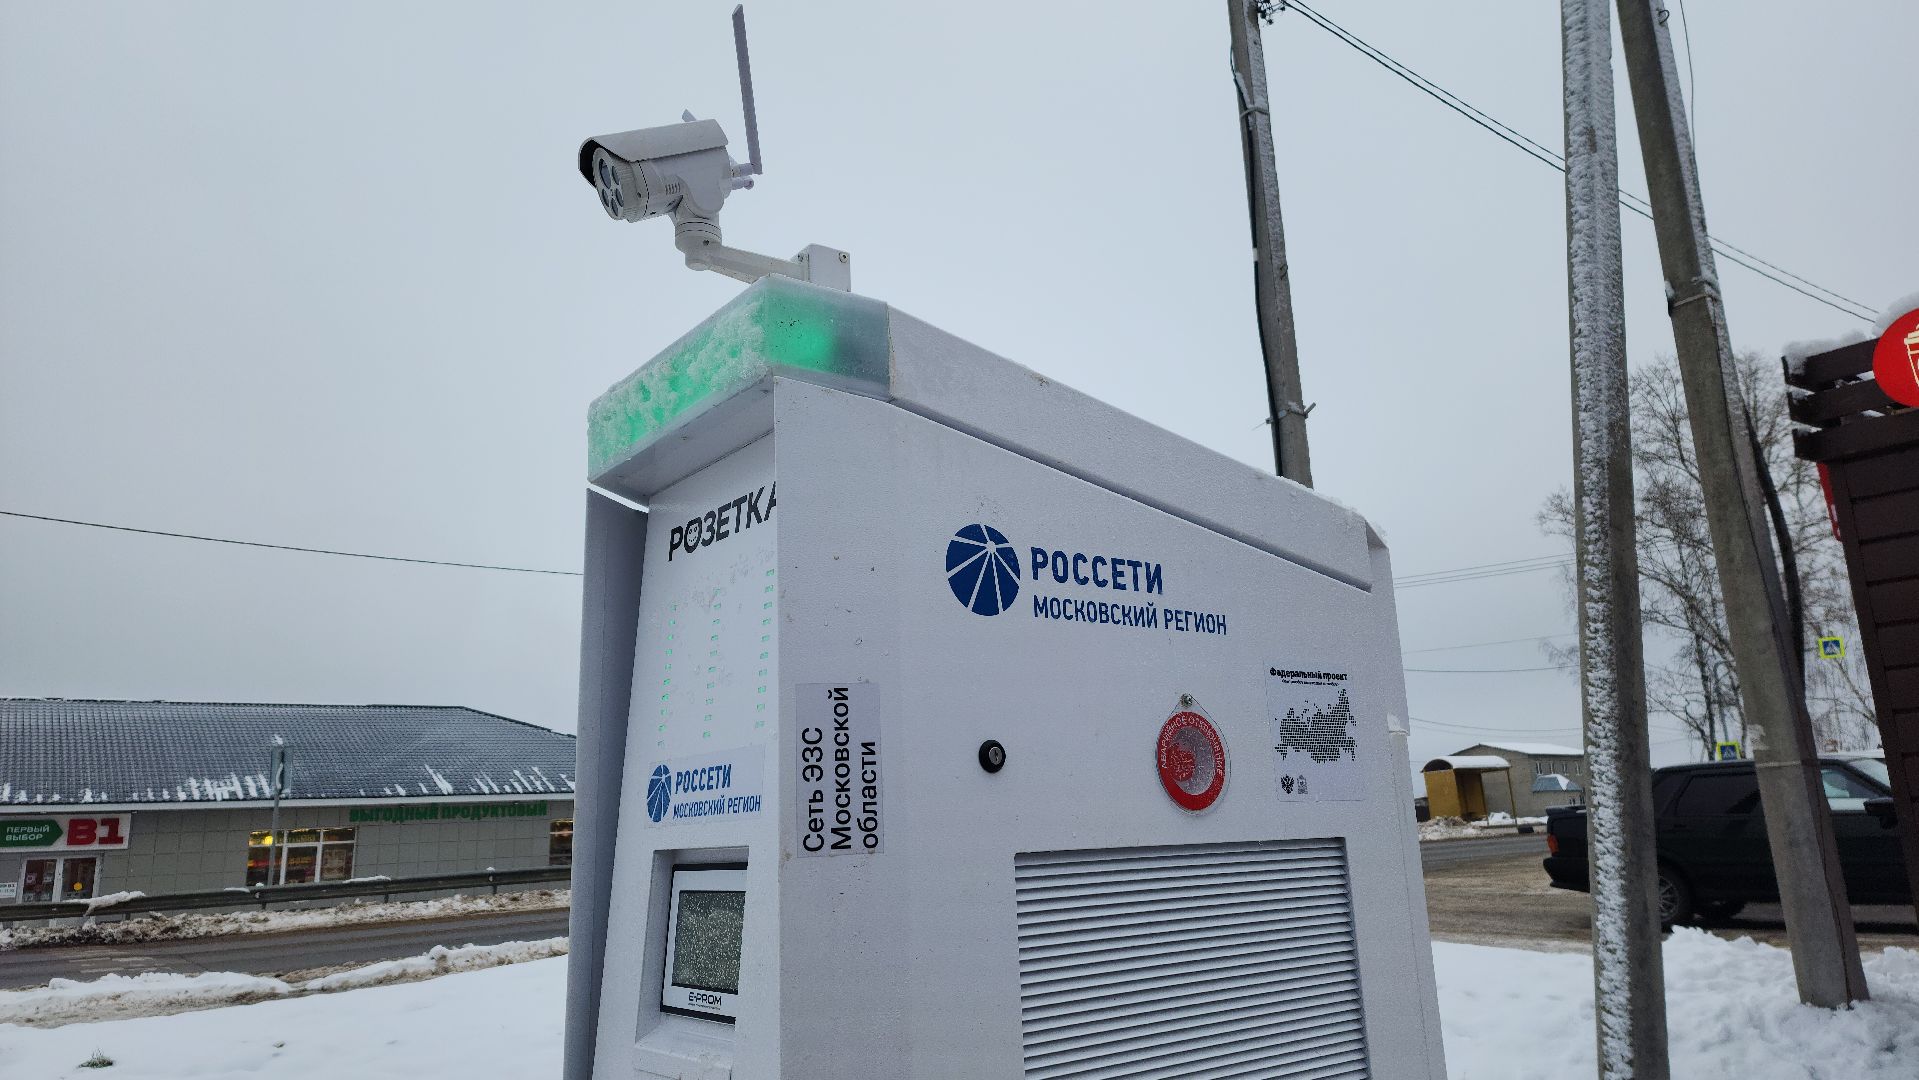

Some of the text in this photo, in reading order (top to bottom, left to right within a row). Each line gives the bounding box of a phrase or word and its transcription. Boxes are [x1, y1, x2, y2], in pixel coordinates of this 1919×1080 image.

[1030, 546, 1163, 595] РОССЕТИ
[1033, 595, 1227, 635] МОСКОВСКИЙ РЕГИОН
[1269, 667, 1348, 681] Федеральный проект
[674, 763, 732, 795] РОССЕТИ
[827, 687, 852, 850] Московской
[801, 727, 825, 852] Сеть ЭЗС
[857, 741, 879, 849] области
[350, 801, 547, 823] ВЫГОДНЫЙ ПРОДУКТОВЫЙ
[672, 794, 761, 820] МОСКОВСКИЙ РЕГИОН
[5, 833, 43, 841] ВЫБОР
[6, 825, 50, 833] ПЕРВЫЙ
[689, 991, 722, 1006] E-PROM
